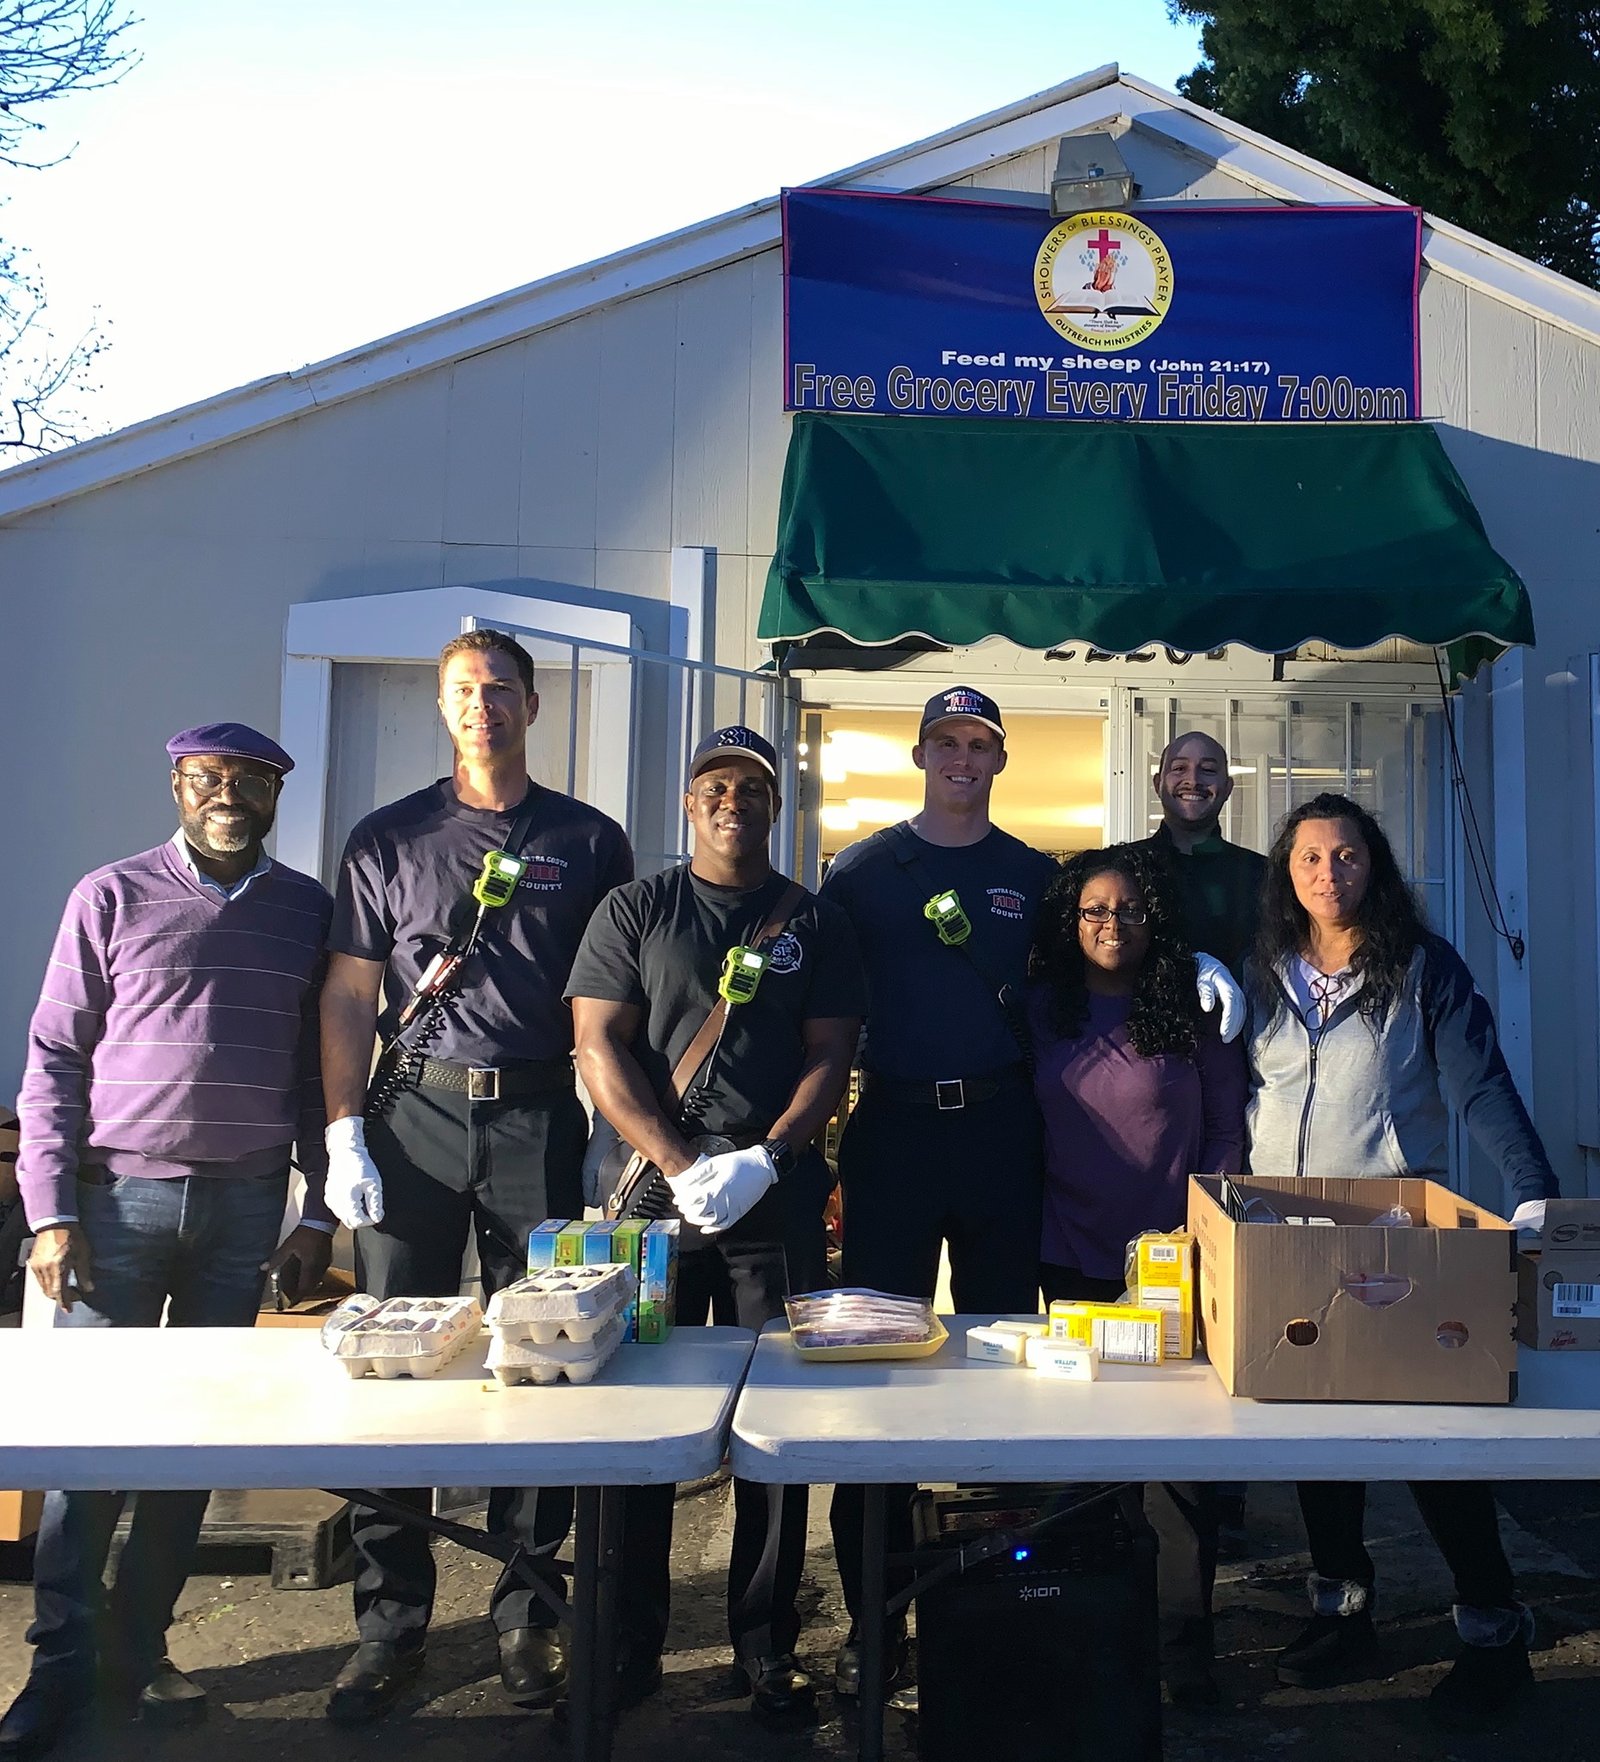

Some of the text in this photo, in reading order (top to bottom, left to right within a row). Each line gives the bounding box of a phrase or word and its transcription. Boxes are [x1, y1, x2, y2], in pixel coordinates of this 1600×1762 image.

[1039, 229, 1067, 299] SHOWERS
[1081, 216, 1154, 245] BLESSINGS
[1151, 246, 1169, 302] PRAYER
[1055, 318, 1153, 346] OUTREACH MINISTRIES
[942, 350, 1270, 375] Feed my sheep (John 21:17)
[794, 363, 1407, 420] Free Grocery Every Friday 7:00pm
[546, 856, 568, 868] COSTA
[519, 880, 562, 890] COUNTY
[991, 907, 1023, 918] COUNTY
[993, 895, 1020, 910] FIRE
